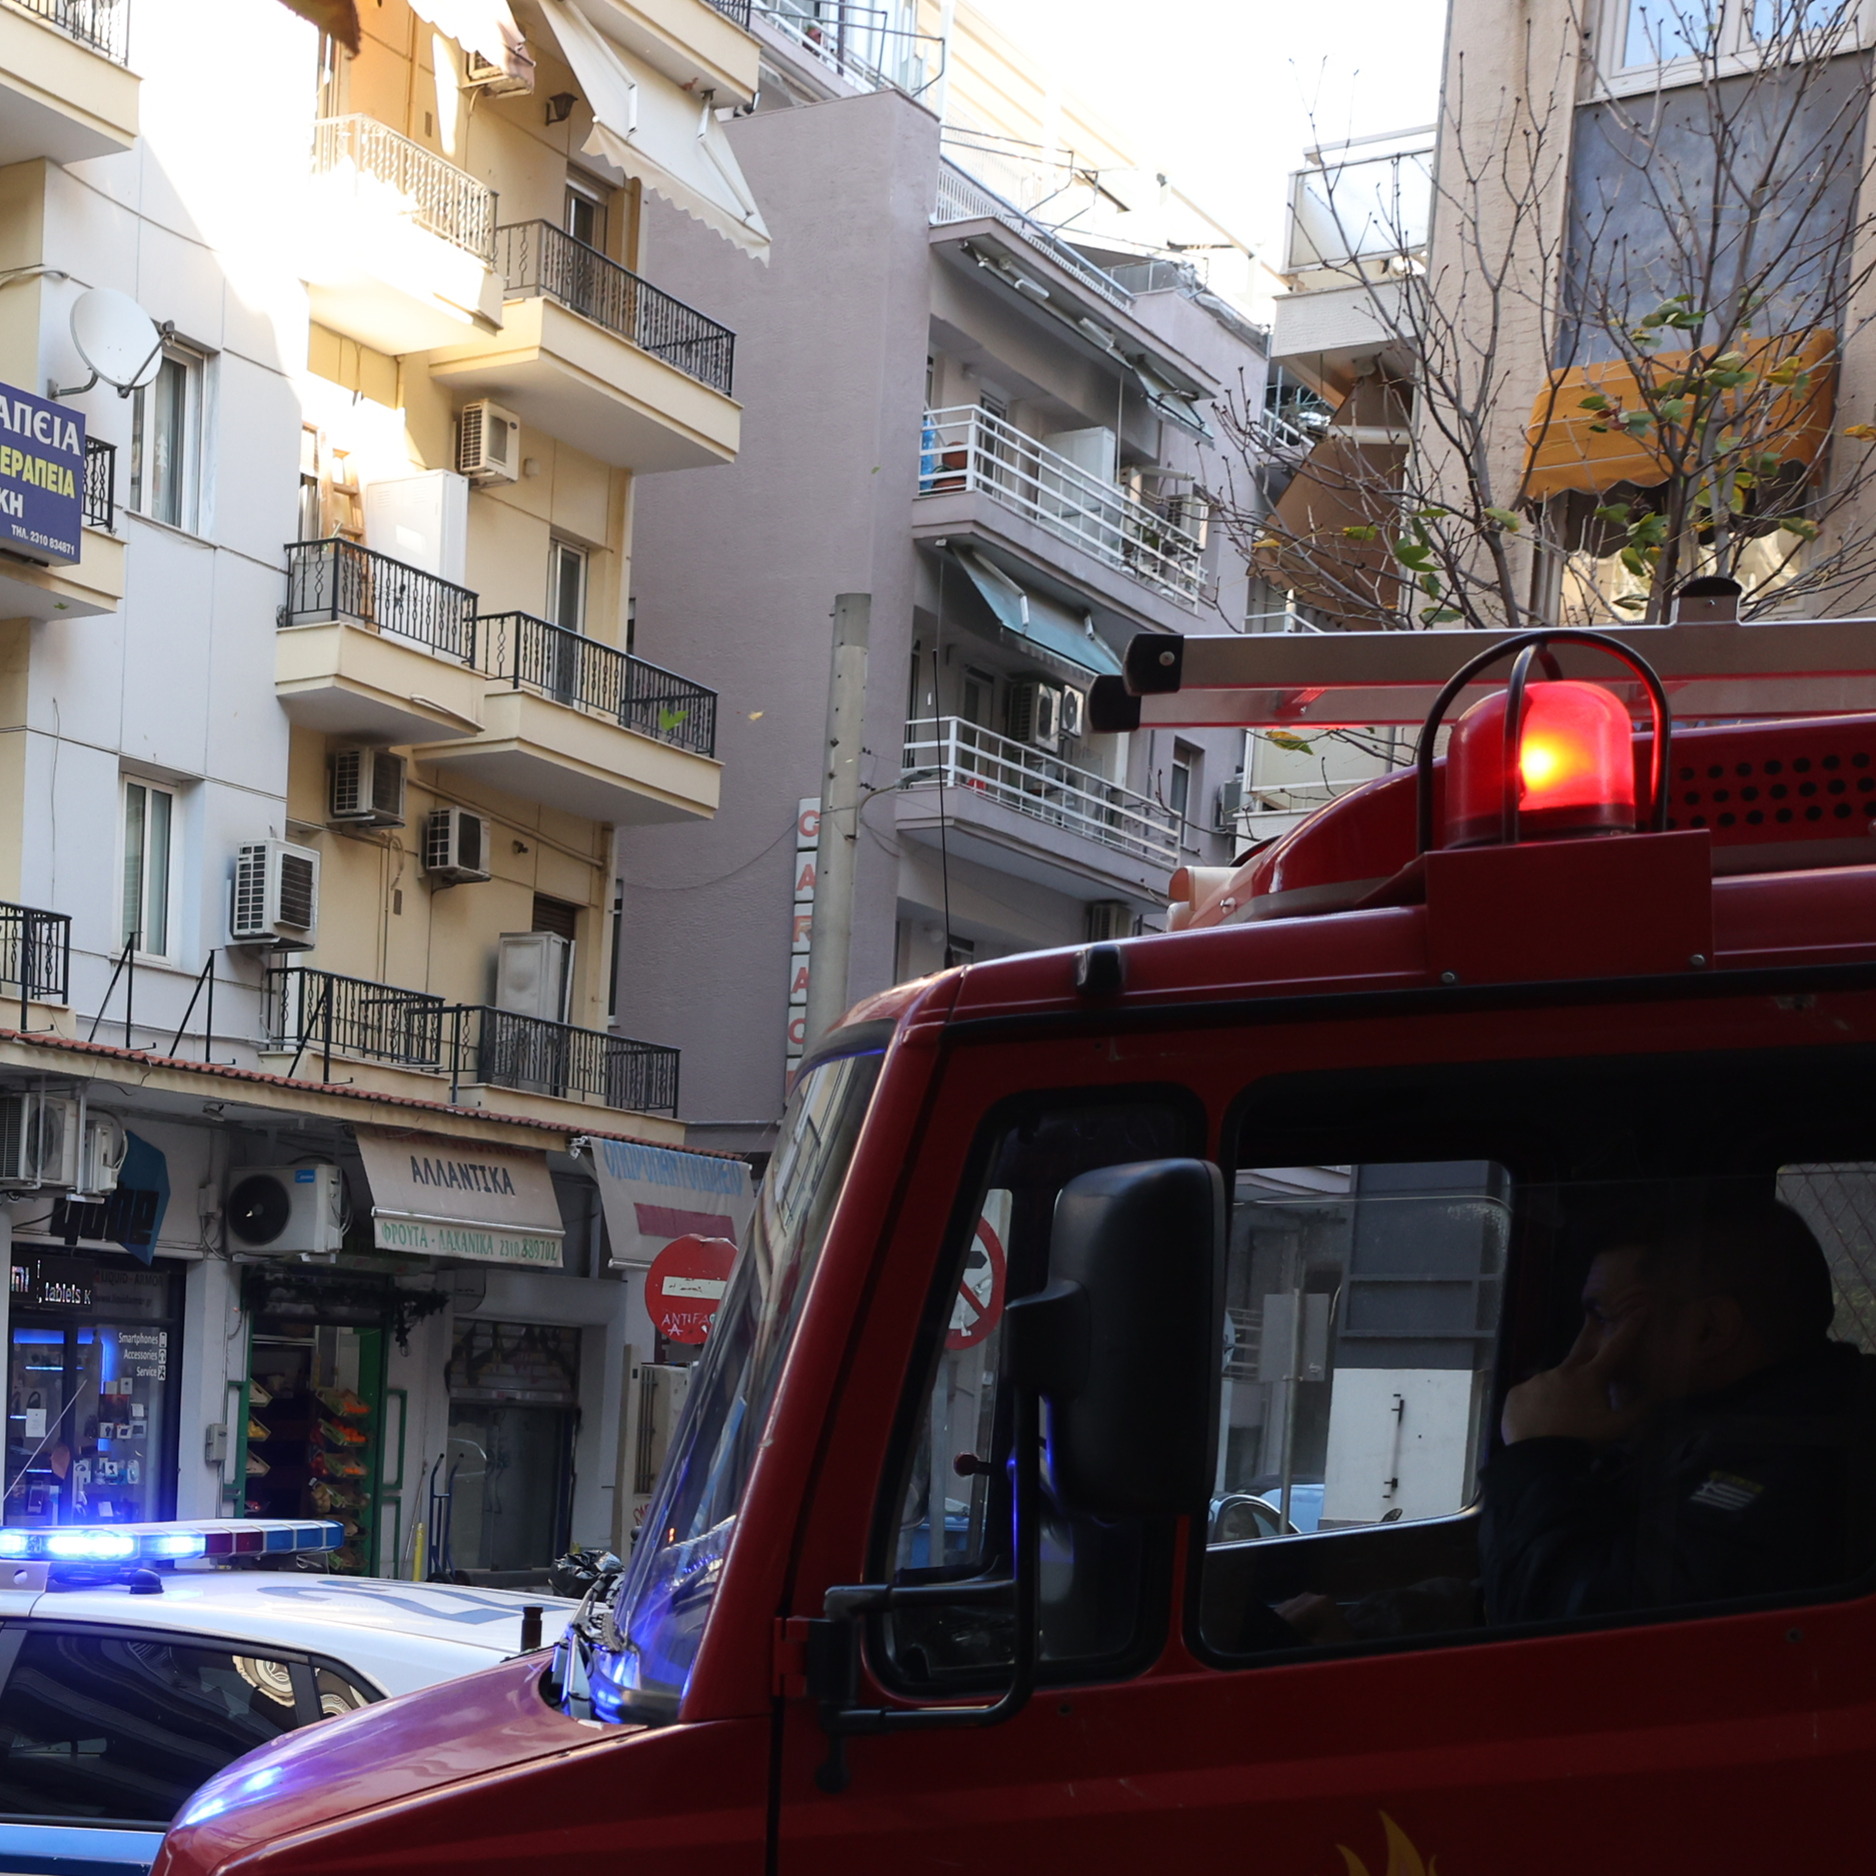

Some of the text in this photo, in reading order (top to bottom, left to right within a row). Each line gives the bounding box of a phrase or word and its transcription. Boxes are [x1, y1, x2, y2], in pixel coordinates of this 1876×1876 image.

[30, 530, 49, 548] 2310
[50, 535, 76, 557] 834871
[410, 1154, 515, 1196] ΑΛΛΑΝΤΙΚΑ
[381, 1221, 429, 1249] ΦΡΟΥΤΑ
[499, 1239, 520, 1258] 2310
[118, 1331, 159, 1346] Smartphones
[123, 1349, 158, 1360] Accessories
[136, 1366, 157, 1377] Service
